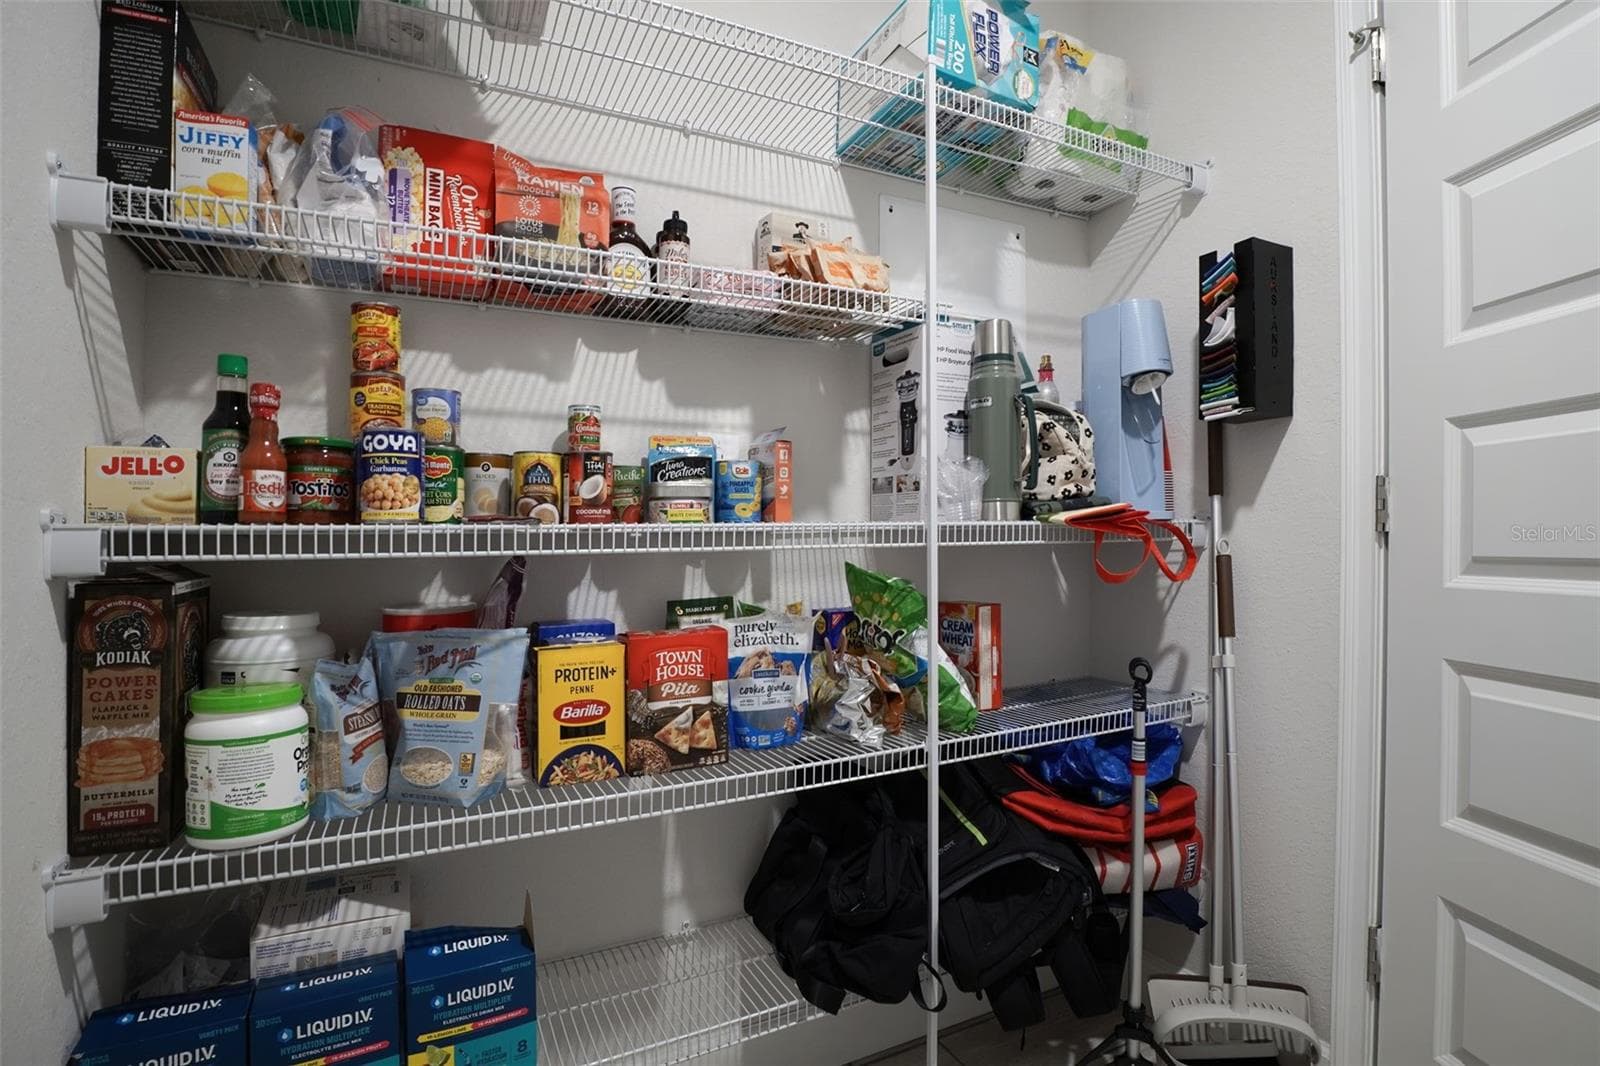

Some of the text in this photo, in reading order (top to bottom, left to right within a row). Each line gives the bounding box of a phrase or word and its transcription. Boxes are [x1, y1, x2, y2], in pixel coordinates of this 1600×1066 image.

[972, 11, 987, 62] FLEX
[986, 9, 1000, 76] POWER
[952, 41, 966, 74] 200
[178, 111, 246, 127] America's Favorite
[179, 127, 243, 149] JIFFY
[181, 146, 241, 159] corn muffin
[201, 157, 221, 165] mix
[429, 171, 441, 202] MINI
[515, 167, 584, 198] RAMEN
[517, 184, 556, 198] NOODLES
[588, 201, 599, 211] 12
[515, 216, 543, 228] LOTUS
[952, 322, 972, 331] smart
[363, 434, 417, 452] GOYA
[101, 455, 185, 476] JELL-O
[585, 461, 604, 470] THAI
[661, 460, 685, 472] Tuna
[735, 467, 749, 475] Dole
[657, 466, 706, 483] Creations
[107, 600, 131, 608] WHOLE
[734, 620, 777, 638] purely
[941, 619, 974, 634] CREAM
[942, 631, 974, 648] WHEAT
[96, 650, 151, 667] KODIAK
[656, 650, 702, 667] TOWN
[555, 665, 617, 683] PROTEIN+
[656, 664, 704, 681] HOUSE
[86, 675, 158, 690] POWER
[414, 684, 463, 693] OLD FASHIONED
[570, 685, 595, 695] PENNE
[661, 682, 701, 698] Pita
[739, 684, 766, 696] cookie
[89, 688, 156, 703] CAKES
[404, 694, 466, 710] ROLLED OATS
[92, 704, 139, 713] FLAPJACK
[410, 711, 434, 719] WHOLE
[561, 704, 605, 720] Barilla
[91, 713, 130, 721] WAFFLE
[83, 788, 155, 802] BUTTERMILK
[107, 808, 146, 820] PROTEIN
[443, 934, 509, 954] LIQUID I.V.
[299, 966, 373, 989] LIQUID I.V.
[447, 977, 515, 1007] LIQUID I.V.
[137, 999, 223, 1023] LIQUID I.V.
[442, 1011, 479, 1026] ELECTROLYTE
[296, 1008, 374, 1040] LIQUID I.V.
[280, 1026, 371, 1057] HYDRATION MULTIPLIER
[291, 1038, 362, 1061] ELECTROLYTE DRINK MIX
[516, 1039, 528, 1052] 8
[195, 1044, 217, 1064] I.V.
